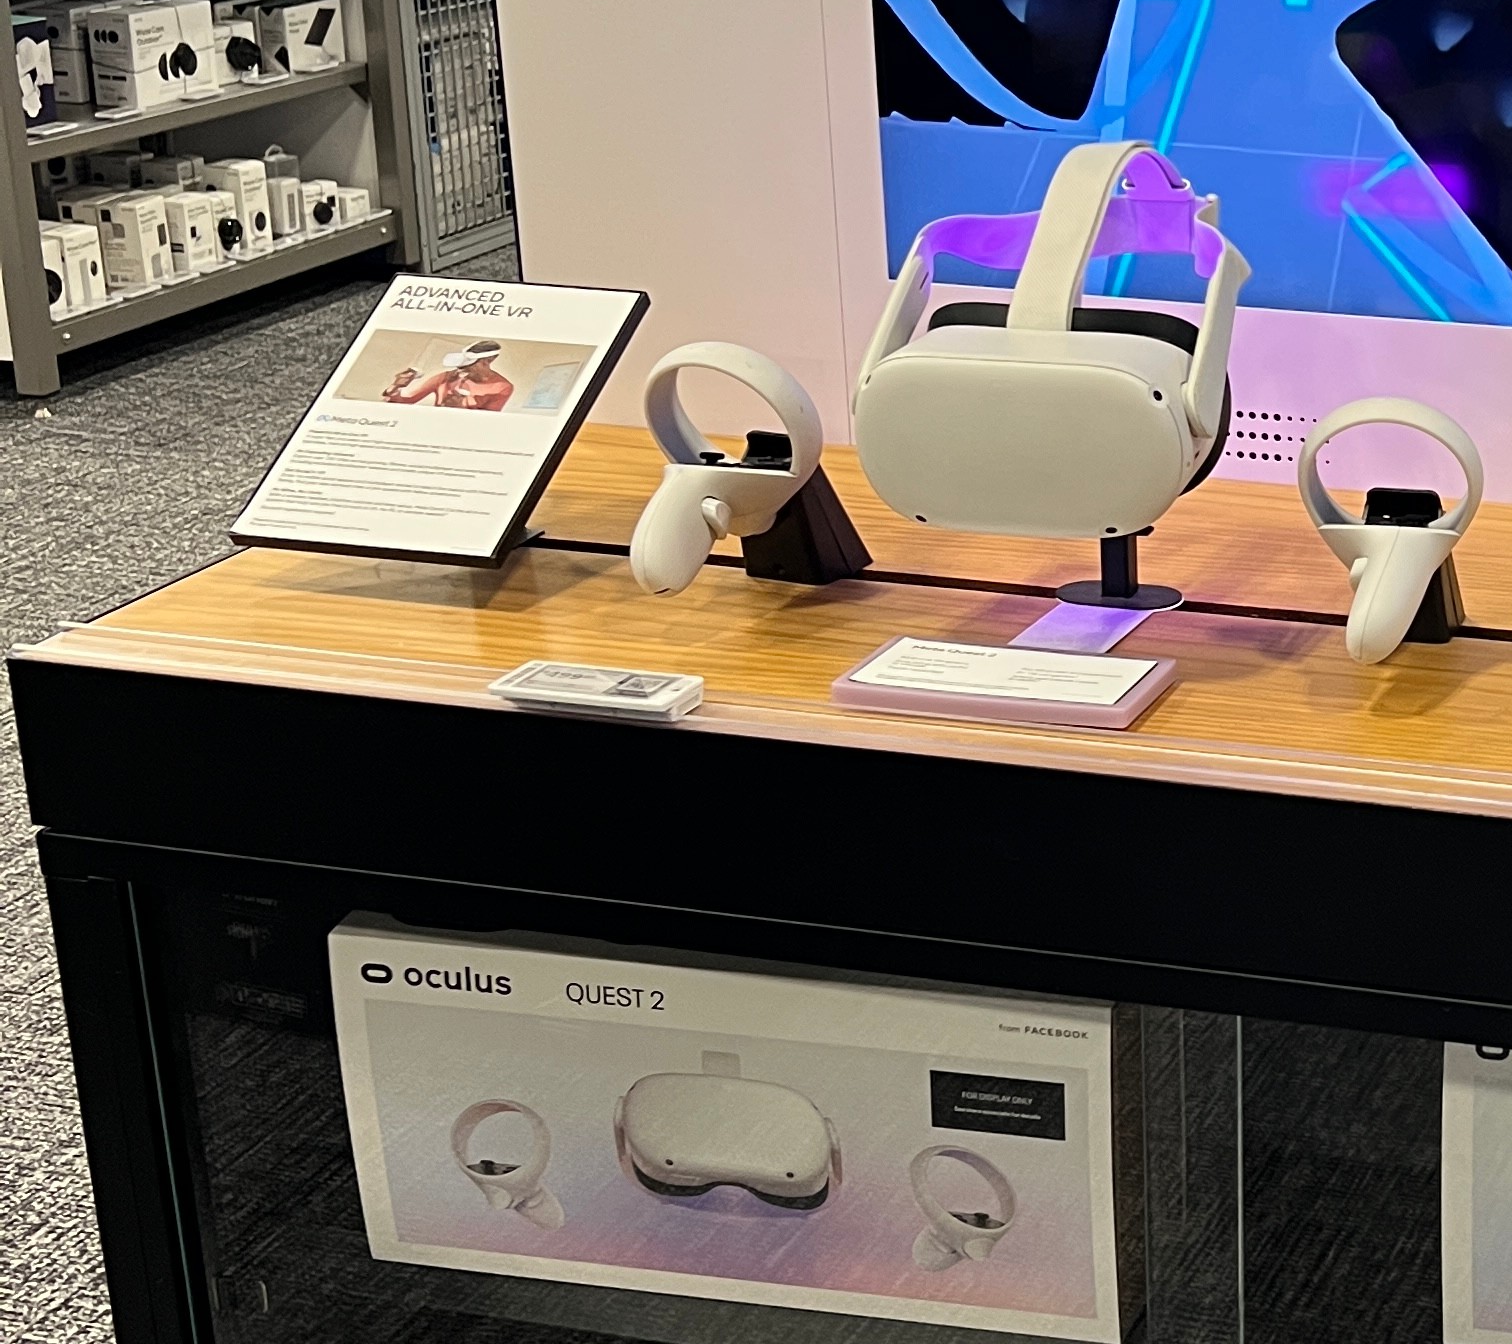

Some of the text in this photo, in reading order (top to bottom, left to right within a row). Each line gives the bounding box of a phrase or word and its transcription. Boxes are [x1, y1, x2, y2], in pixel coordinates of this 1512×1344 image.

[399, 285, 505, 302] ADVANCED
[391, 298, 533, 318] ALL-IN-ONE VR
[404, 966, 665, 1010] oculus QUEST 2
[1024, 1026, 1089, 1039] FACEBOOK
